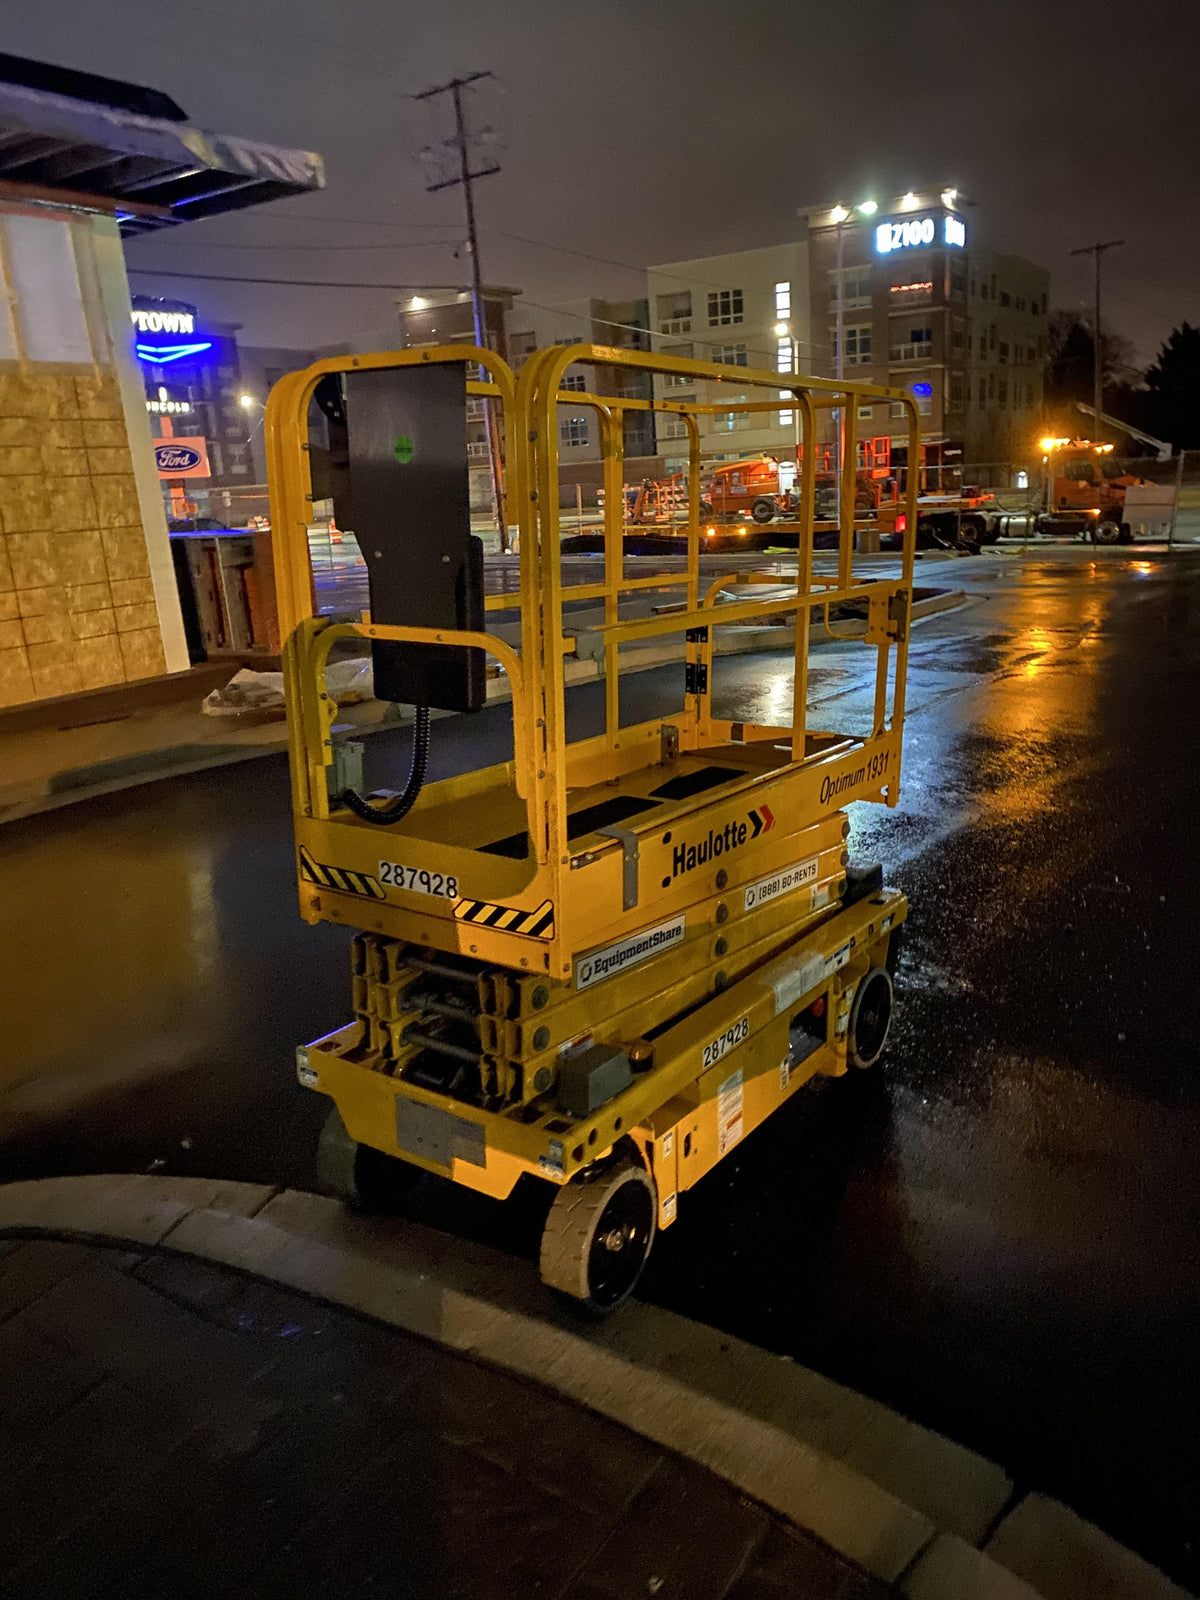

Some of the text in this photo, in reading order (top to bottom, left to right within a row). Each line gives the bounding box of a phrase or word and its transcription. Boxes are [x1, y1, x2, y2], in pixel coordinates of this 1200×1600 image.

[159, 450, 191, 467] Ford
[820, 749, 890, 806] Optimum 1931
[672, 820, 747, 878] Haulotte
[380, 861, 458, 899] 287928
[593, 924, 682, 975] EquipmentShare
[703, 1017, 749, 1068] 287928
